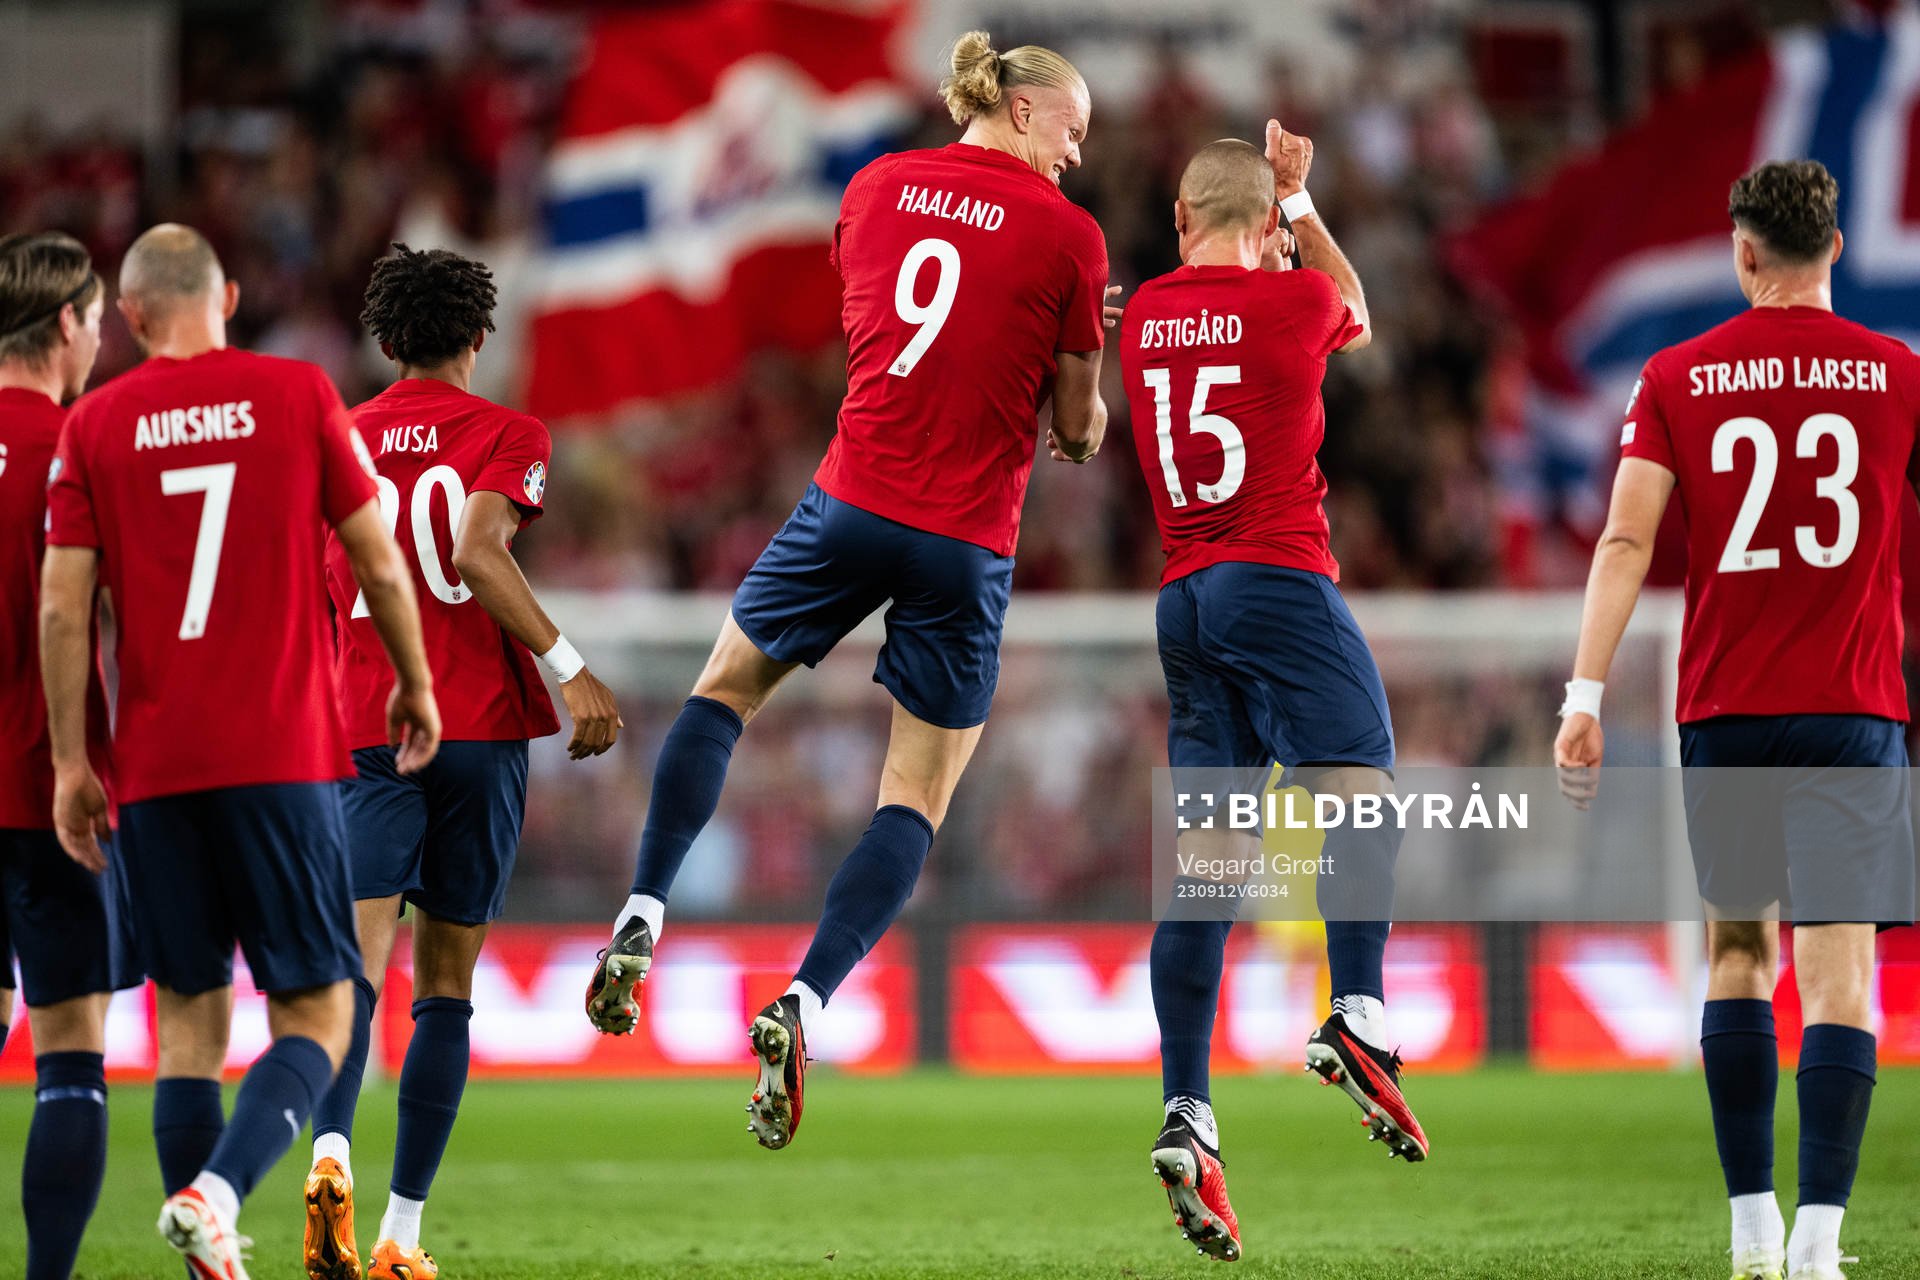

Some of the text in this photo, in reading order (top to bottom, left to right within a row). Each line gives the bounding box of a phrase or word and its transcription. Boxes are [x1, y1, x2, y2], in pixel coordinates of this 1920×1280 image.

[896, 184, 1005, 231] HAALAND
[887, 237, 961, 377] 9
[1140, 308, 1243, 349] ØSTIGÅRD
[1689, 356, 1887, 397] STRAND LARSEN
[134, 400, 256, 451] AURSNES
[380, 425, 438, 455] NUSA
[1142, 365, 1246, 508] 15
[1711, 413, 1860, 573] 23
[160, 462, 236, 640] 7
